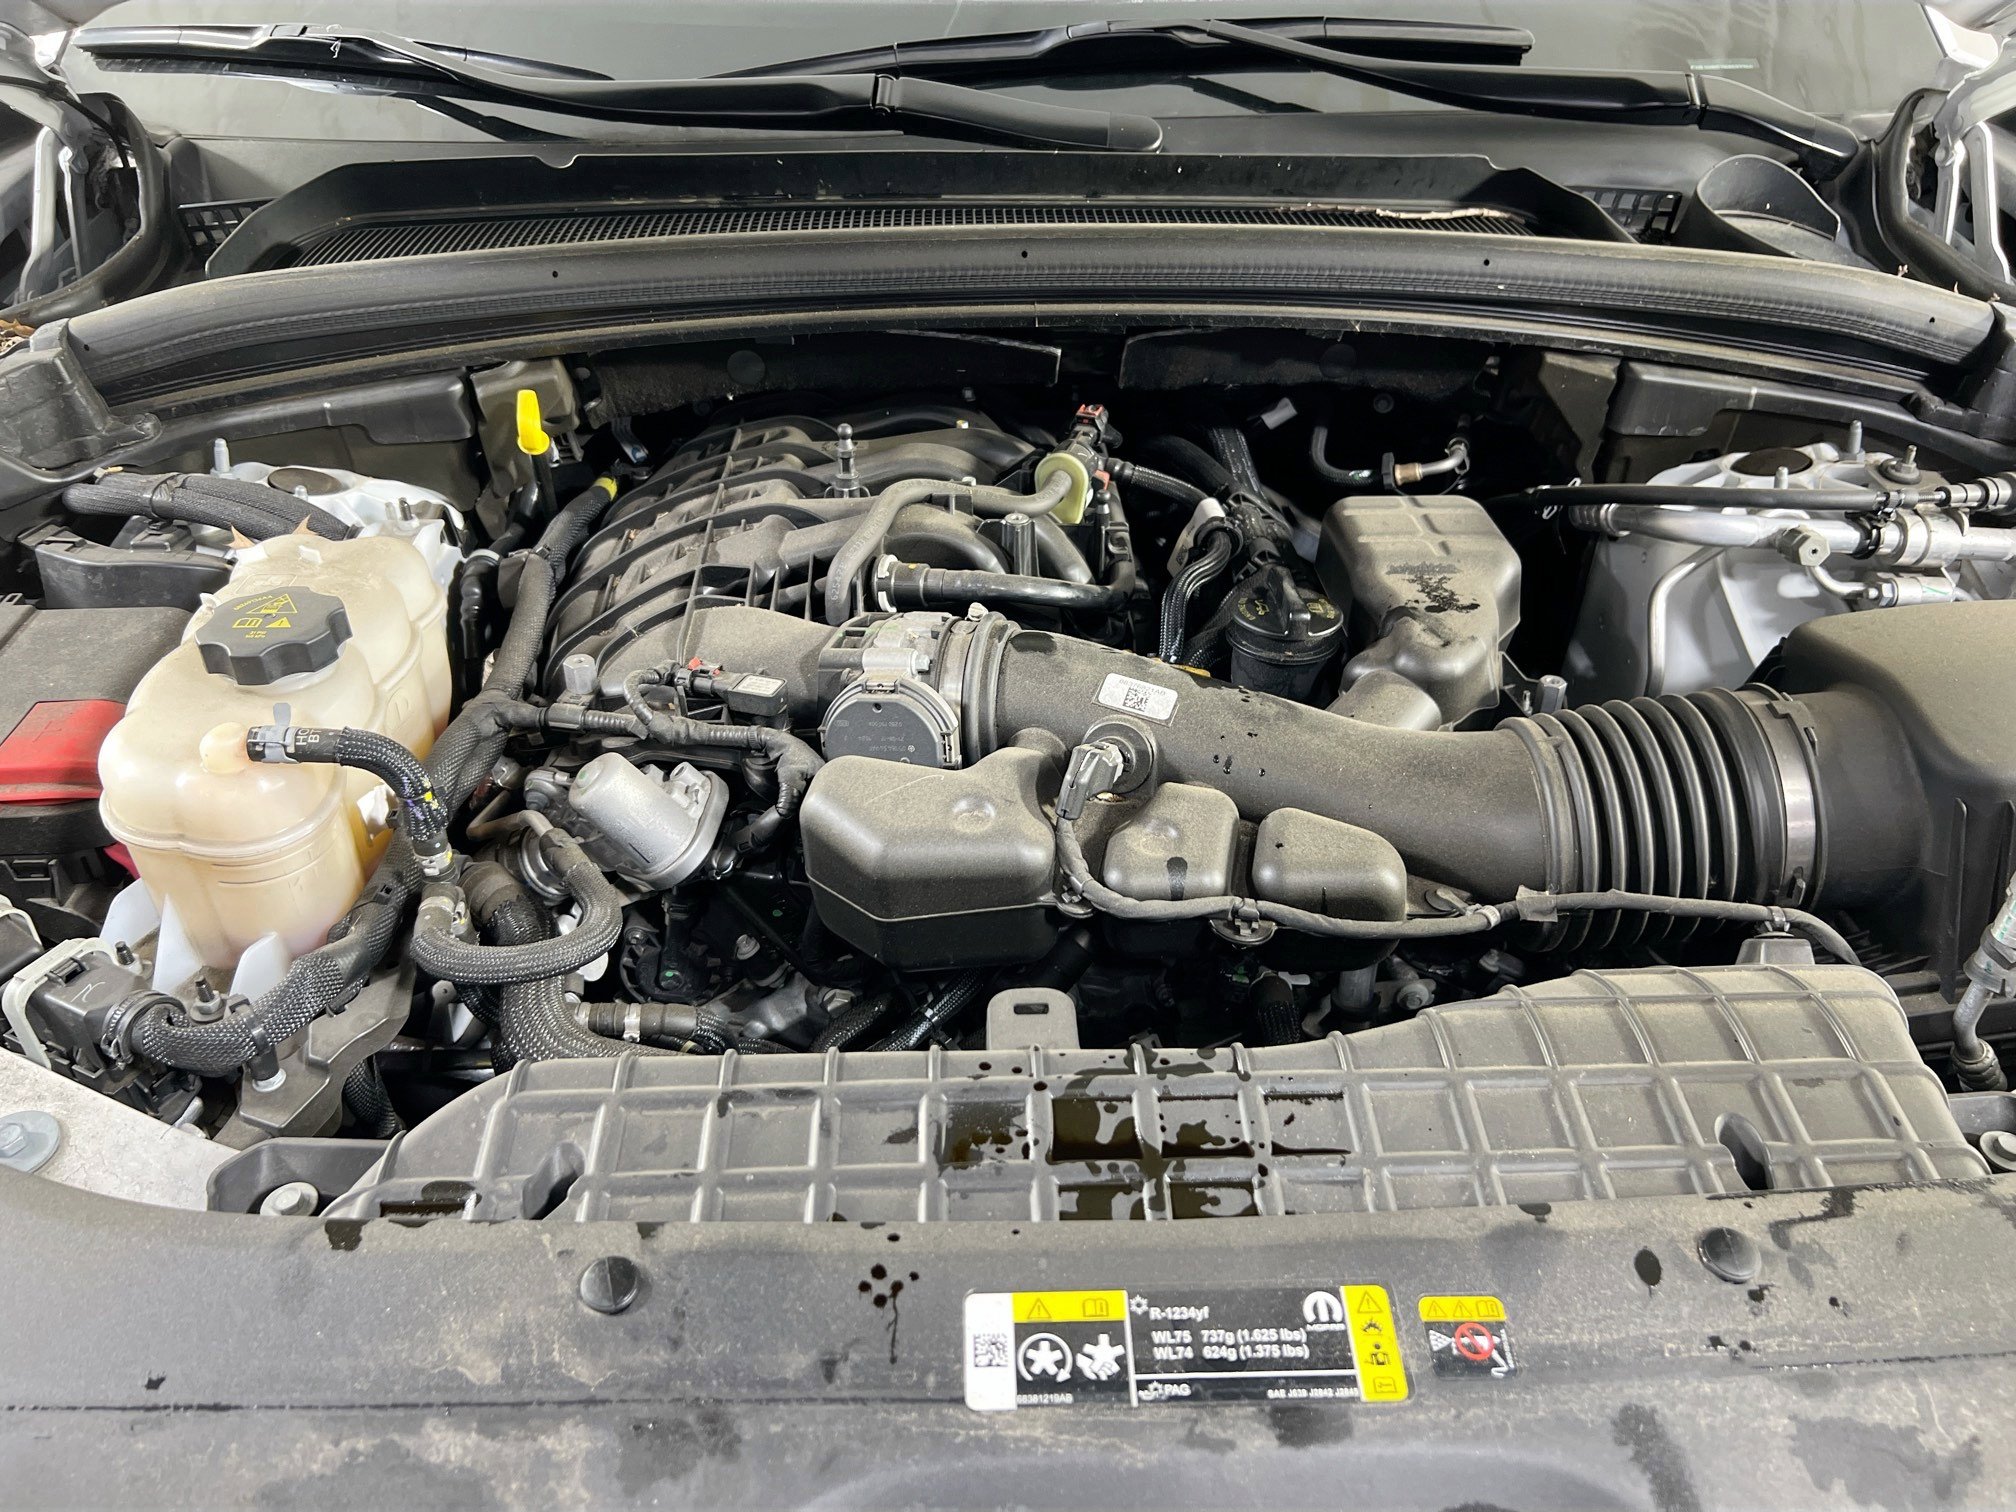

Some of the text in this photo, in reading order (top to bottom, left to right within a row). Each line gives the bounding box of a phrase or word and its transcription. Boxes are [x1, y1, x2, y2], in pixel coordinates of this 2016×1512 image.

[1150, 1306, 1210, 1322] R-1234yf
[1151, 1327, 1307, 1345] WL75 737g (1.625 lbs)
[1153, 1343, 1310, 1362] WL74 624g (1.375 lbs)
[1164, 1383, 1191, 1397] PAG
